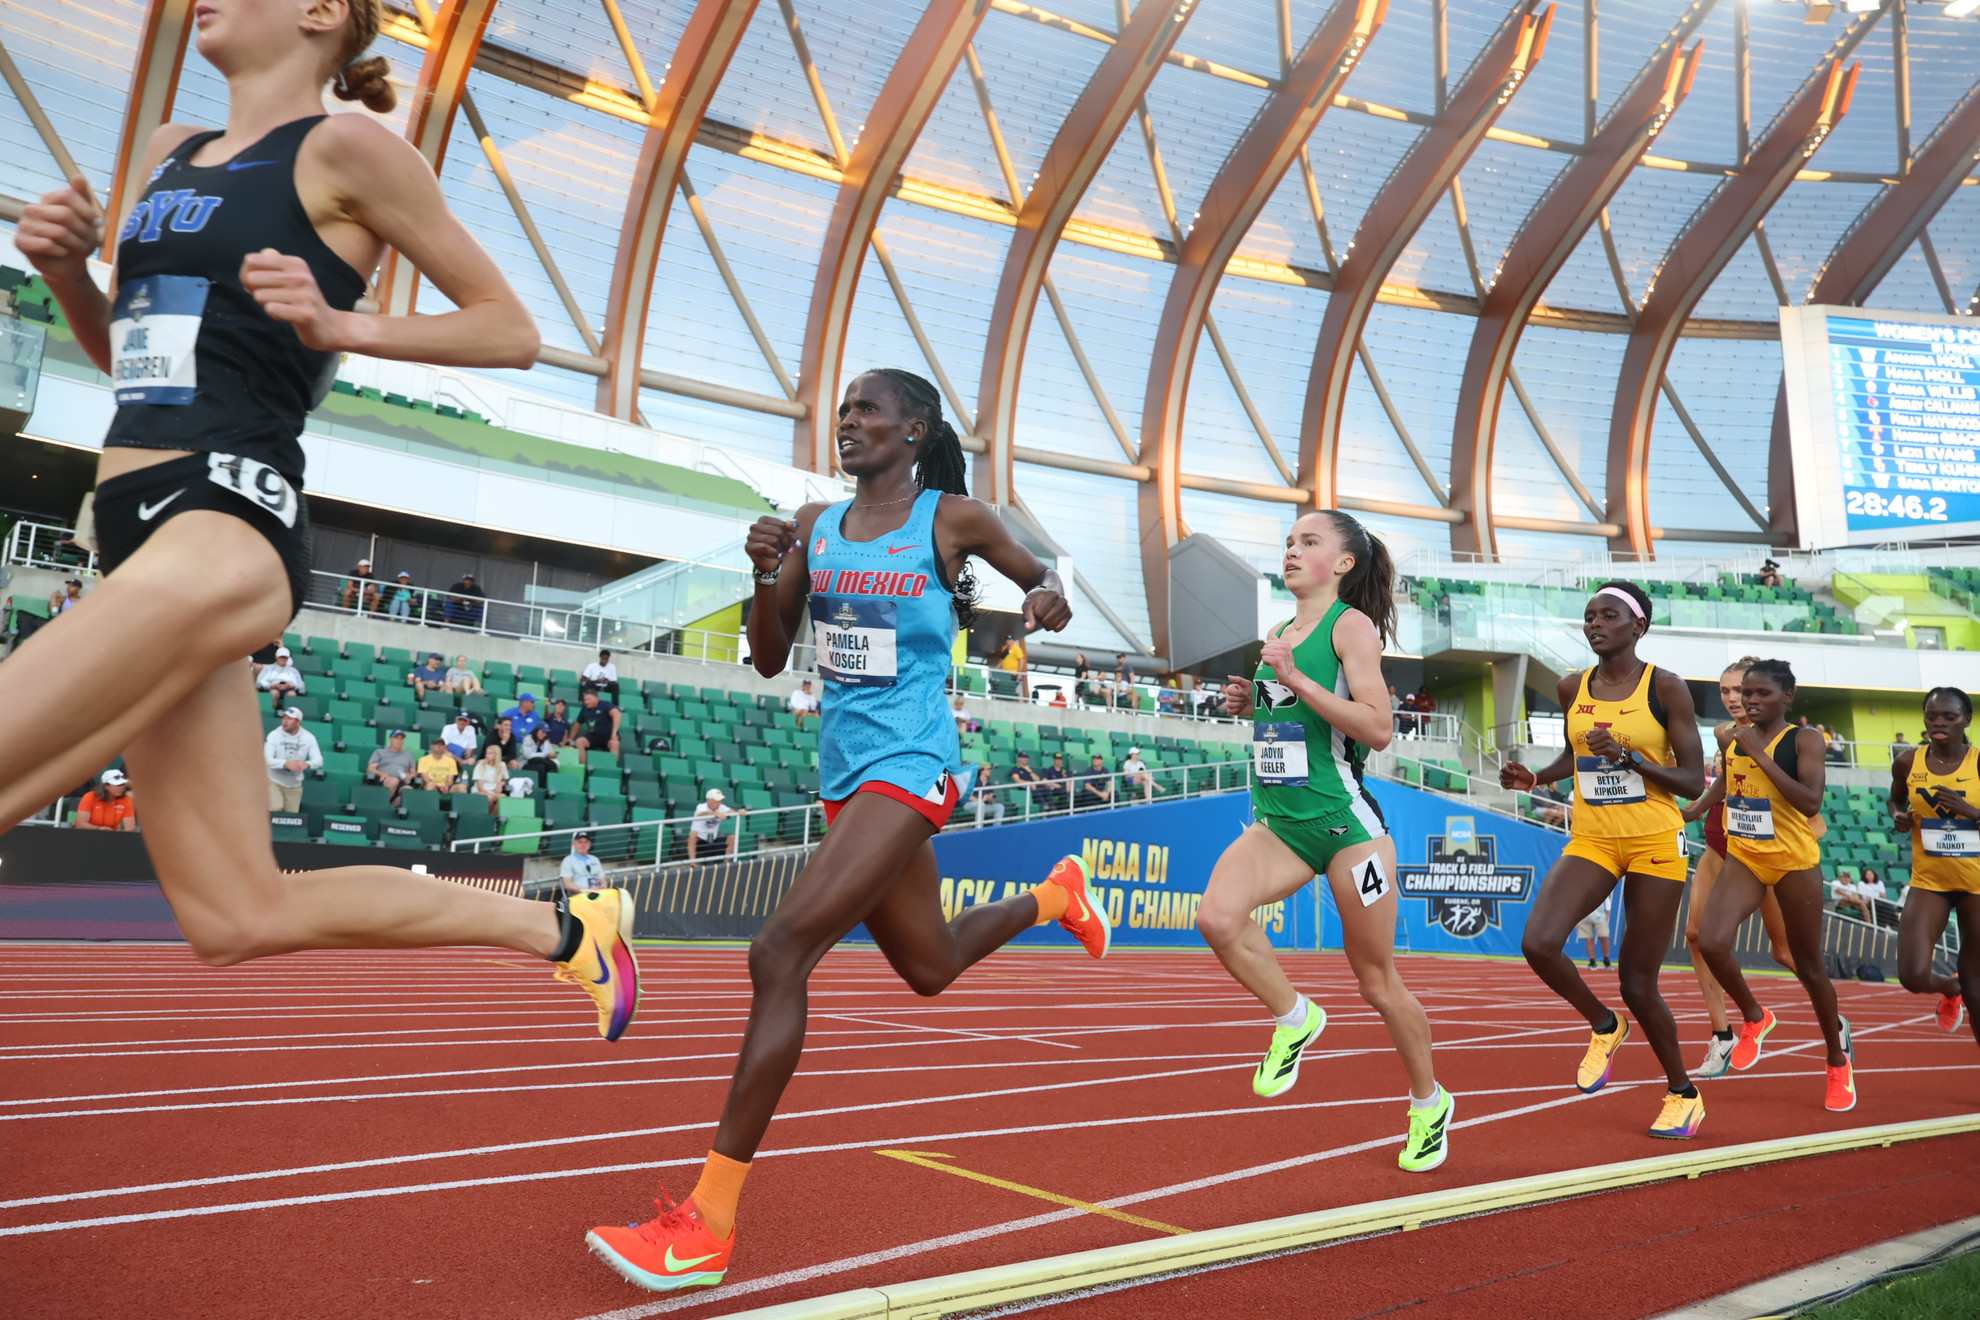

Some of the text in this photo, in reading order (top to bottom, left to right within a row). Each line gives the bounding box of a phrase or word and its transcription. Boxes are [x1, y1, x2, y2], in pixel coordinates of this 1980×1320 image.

[1875, 323, 1955, 342] WOMEN'S
[1837, 392, 1845, 404] 4
[1927, 385, 1976, 400] WILLIS
[1841, 439, 1849, 451] 7
[1925, 447, 1976, 462] EVANS
[1847, 491, 1948, 521] 28:46.2
[809, 570, 928, 597] EW MEXICO
[826, 632, 870, 651] PAMELA
[829, 651, 867, 670] KOSGEI
[1261, 747, 1284, 759] JADYN
[1596, 775, 1621, 786] BETTY
[1594, 786, 1629, 797] KIPKORE
[271, 816, 303, 826] RESERVED
[330, 822, 362, 832] RESERVED
[1943, 833, 1957, 842] JOY
[1081, 838, 1169, 884] NCAA DI
[1429, 862, 1495, 876] TRACK & FIELD
[1361, 860, 1384, 896] 4
[1405, 874, 1522, 894] CHAMPIONSHIPS
